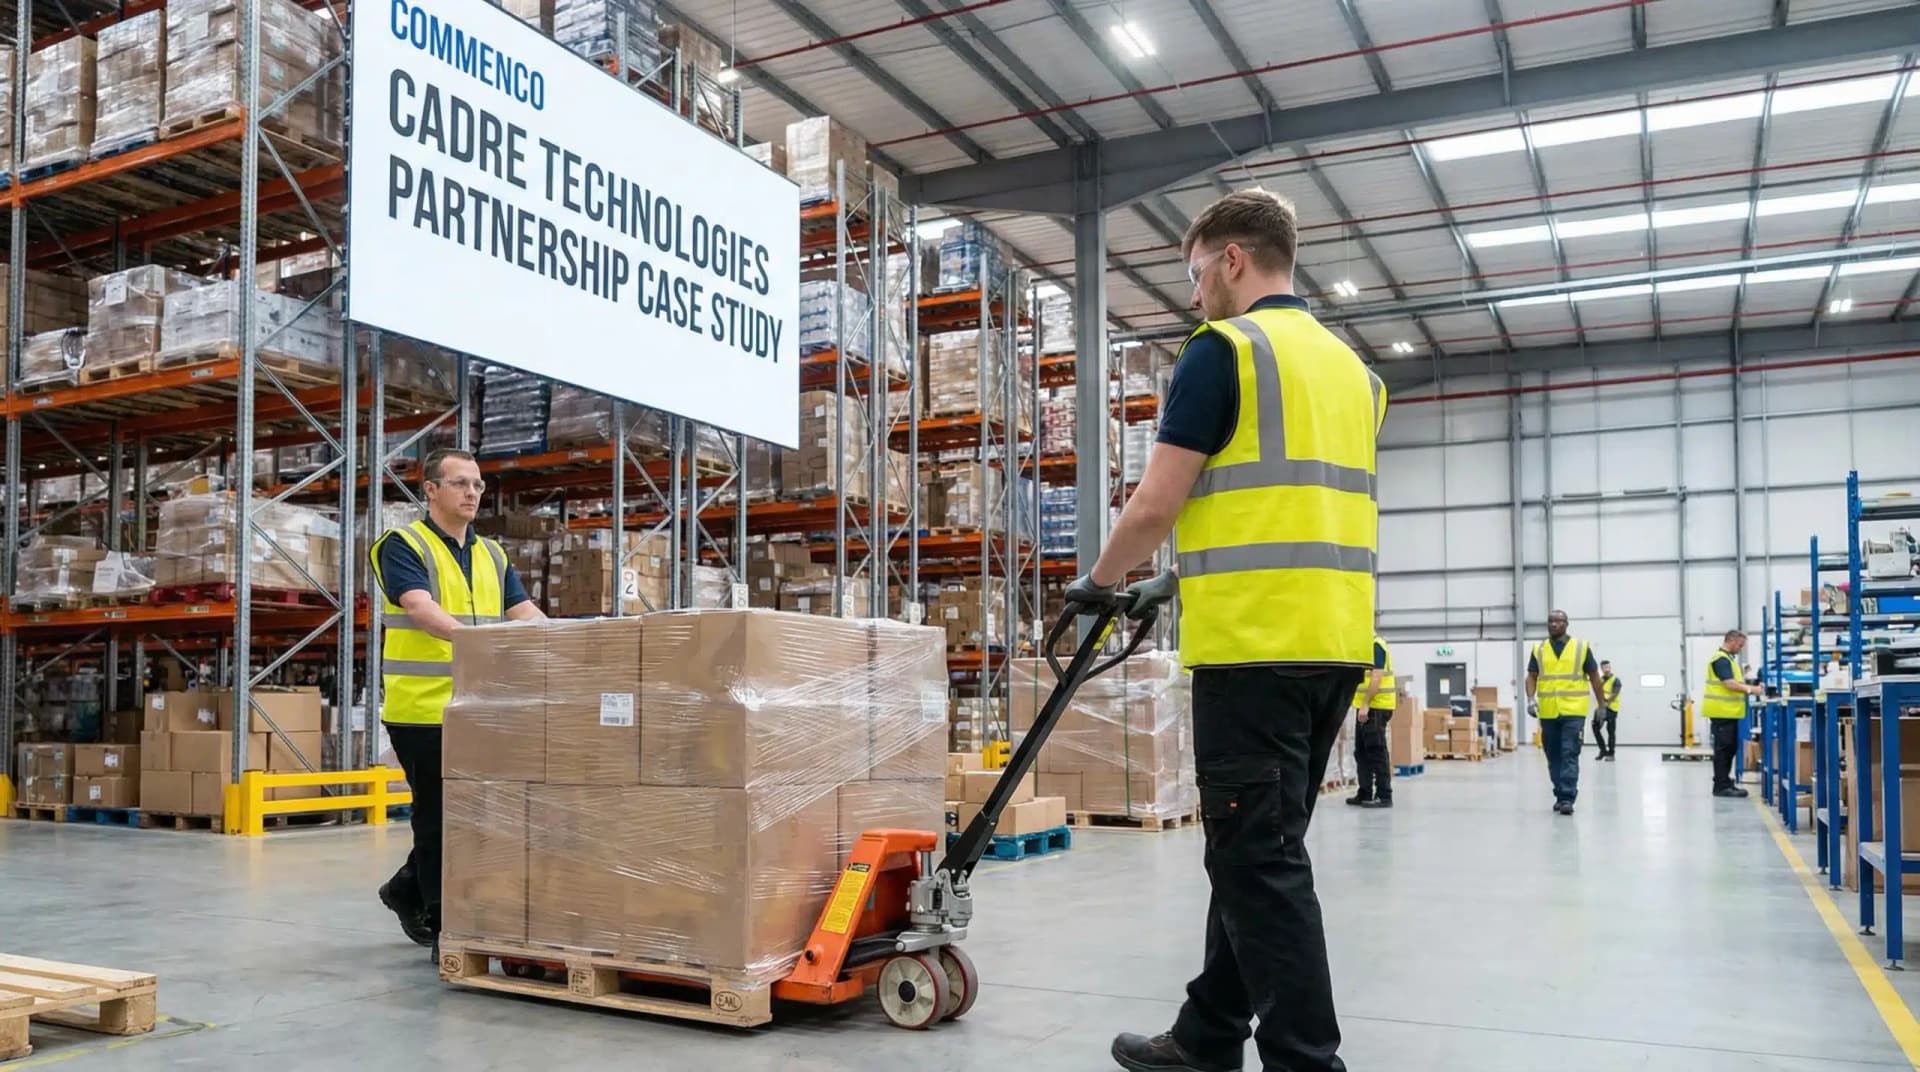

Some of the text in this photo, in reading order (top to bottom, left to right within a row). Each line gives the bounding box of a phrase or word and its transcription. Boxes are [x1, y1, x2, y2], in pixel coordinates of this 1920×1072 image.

[390, 0, 545, 111] COMMENCO
[388, 153, 783, 364] PARTNERSHIP CASE STUDY
[389, 68, 769, 296] CADRE TECHNOLOGIES
